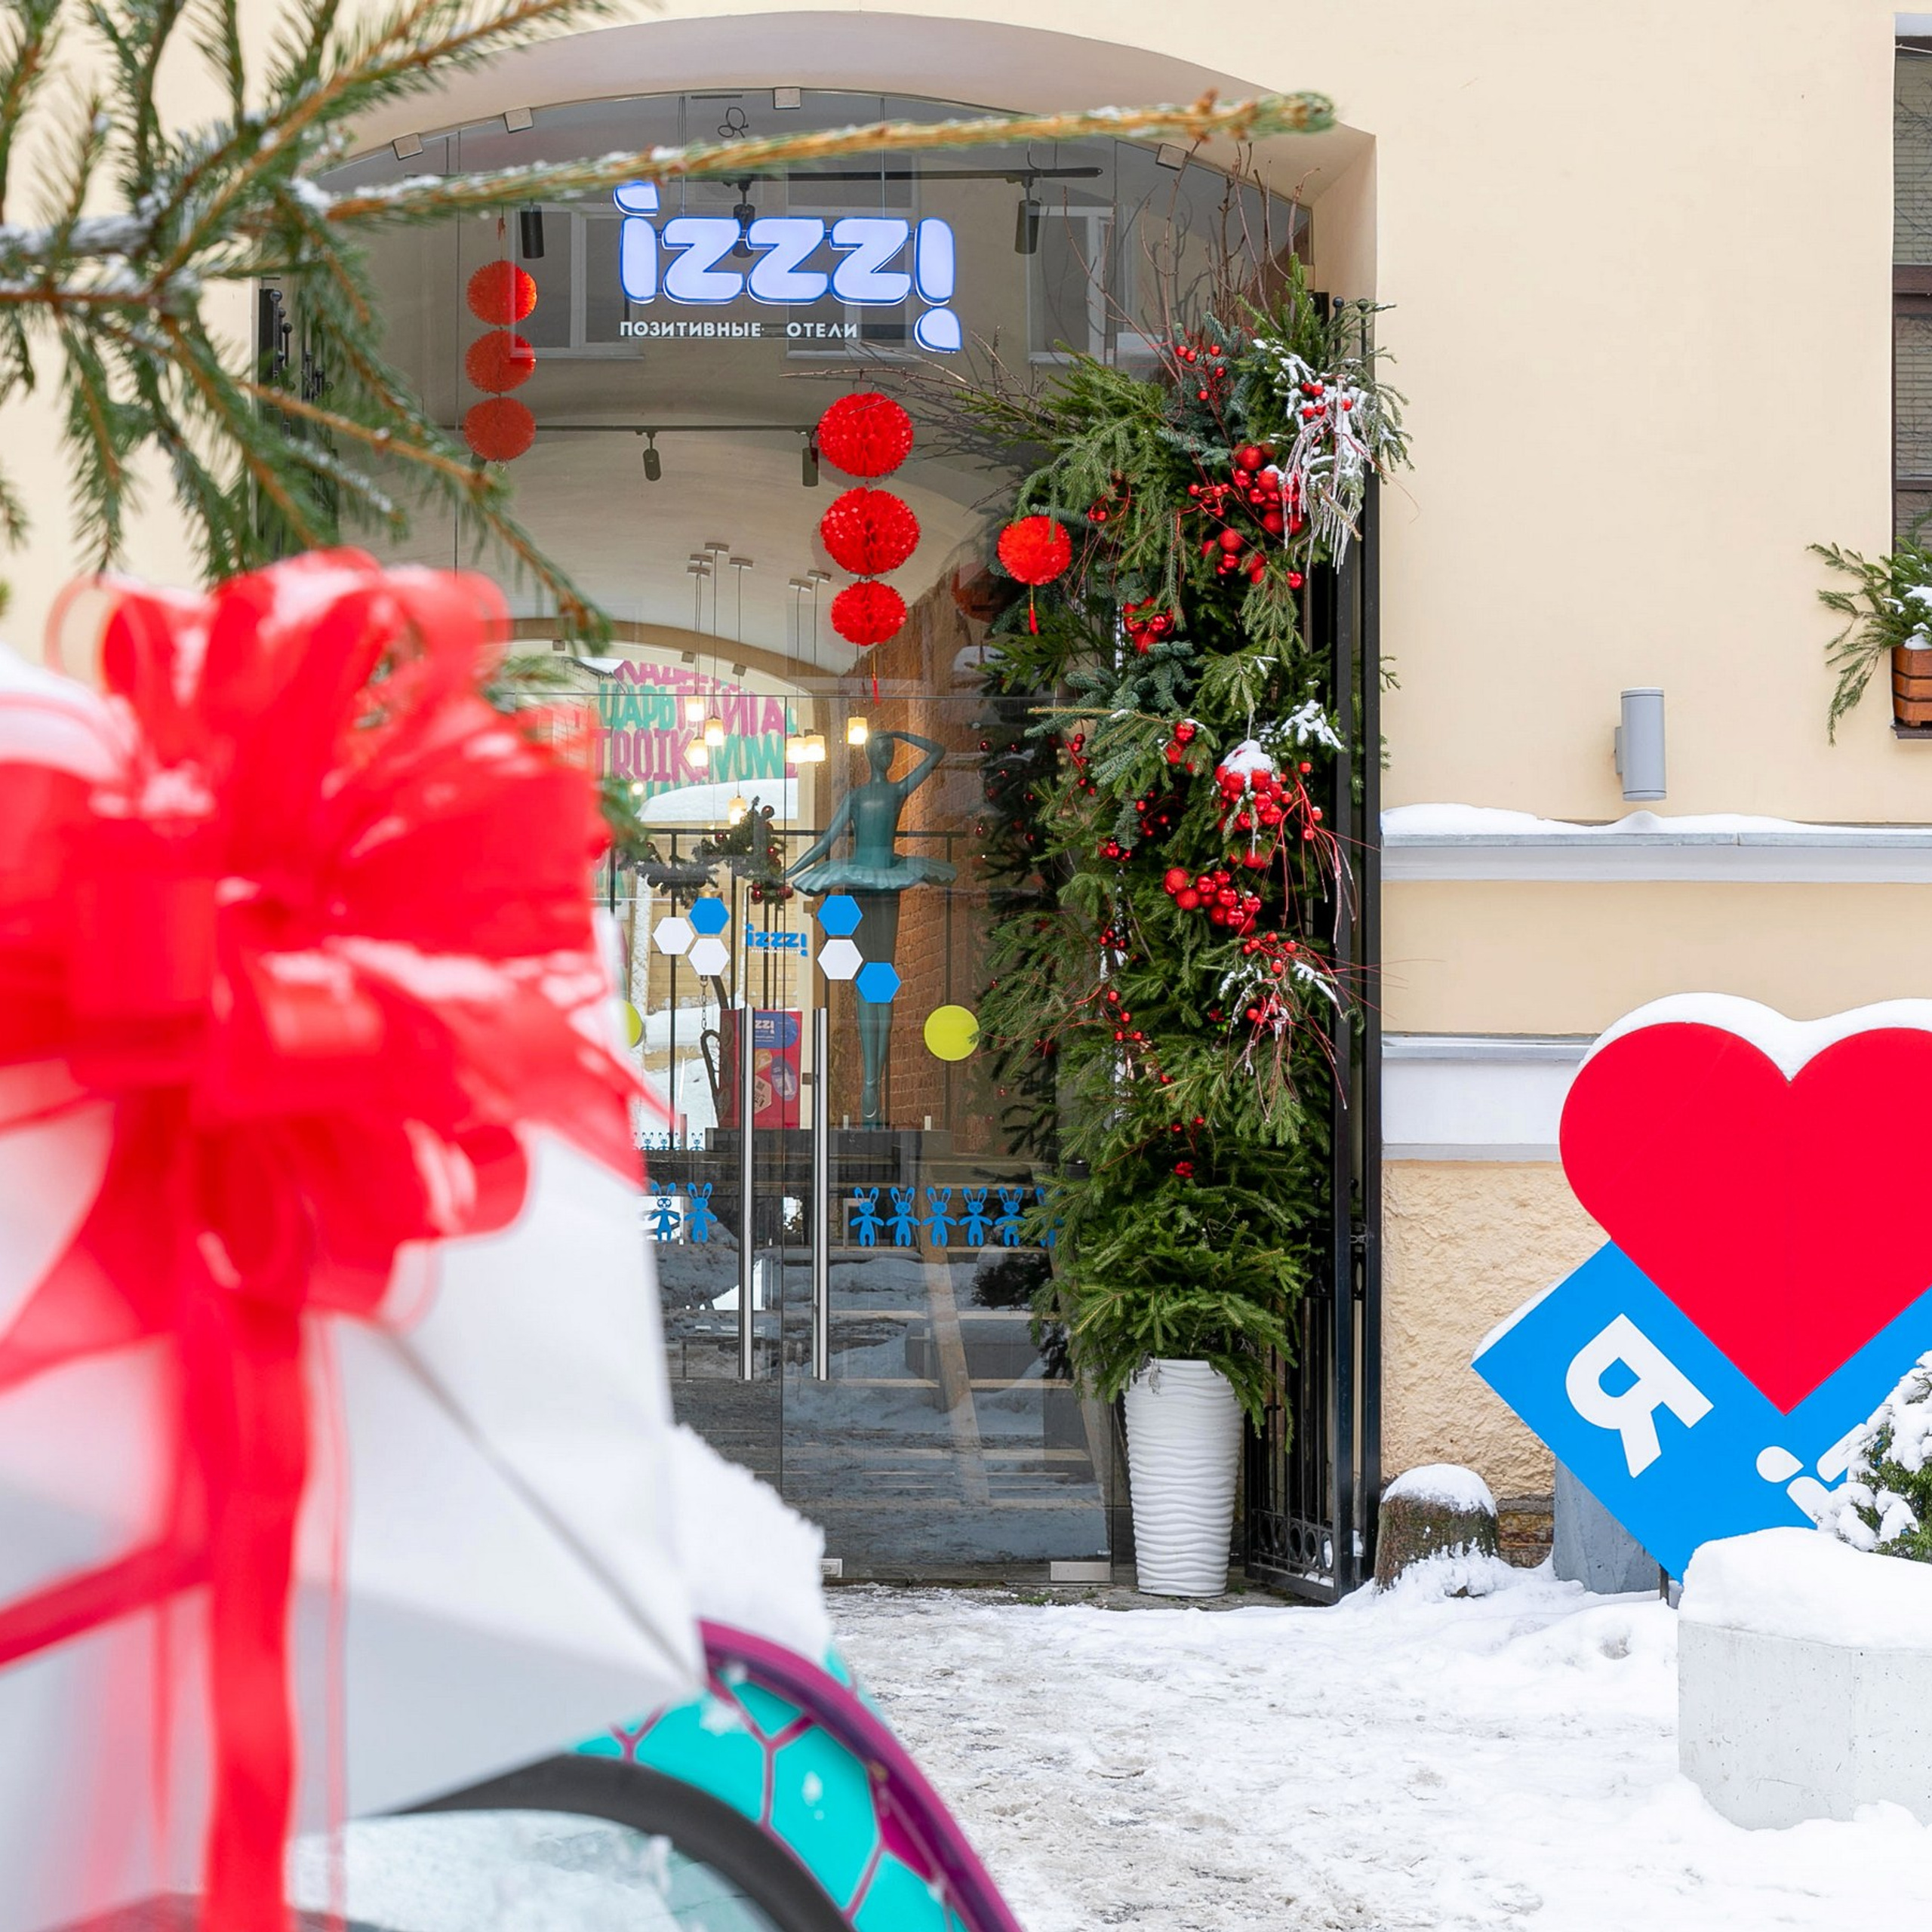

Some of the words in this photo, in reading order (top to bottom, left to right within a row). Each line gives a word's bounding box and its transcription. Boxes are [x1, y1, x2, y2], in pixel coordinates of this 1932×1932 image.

[614, 180, 962, 353] izzz!
[620, 321, 762, 337] ПОЗИТИВНЫЕ
[786, 322, 858, 338] ОТЕЛИ
[746, 923, 808, 957] izzz!
